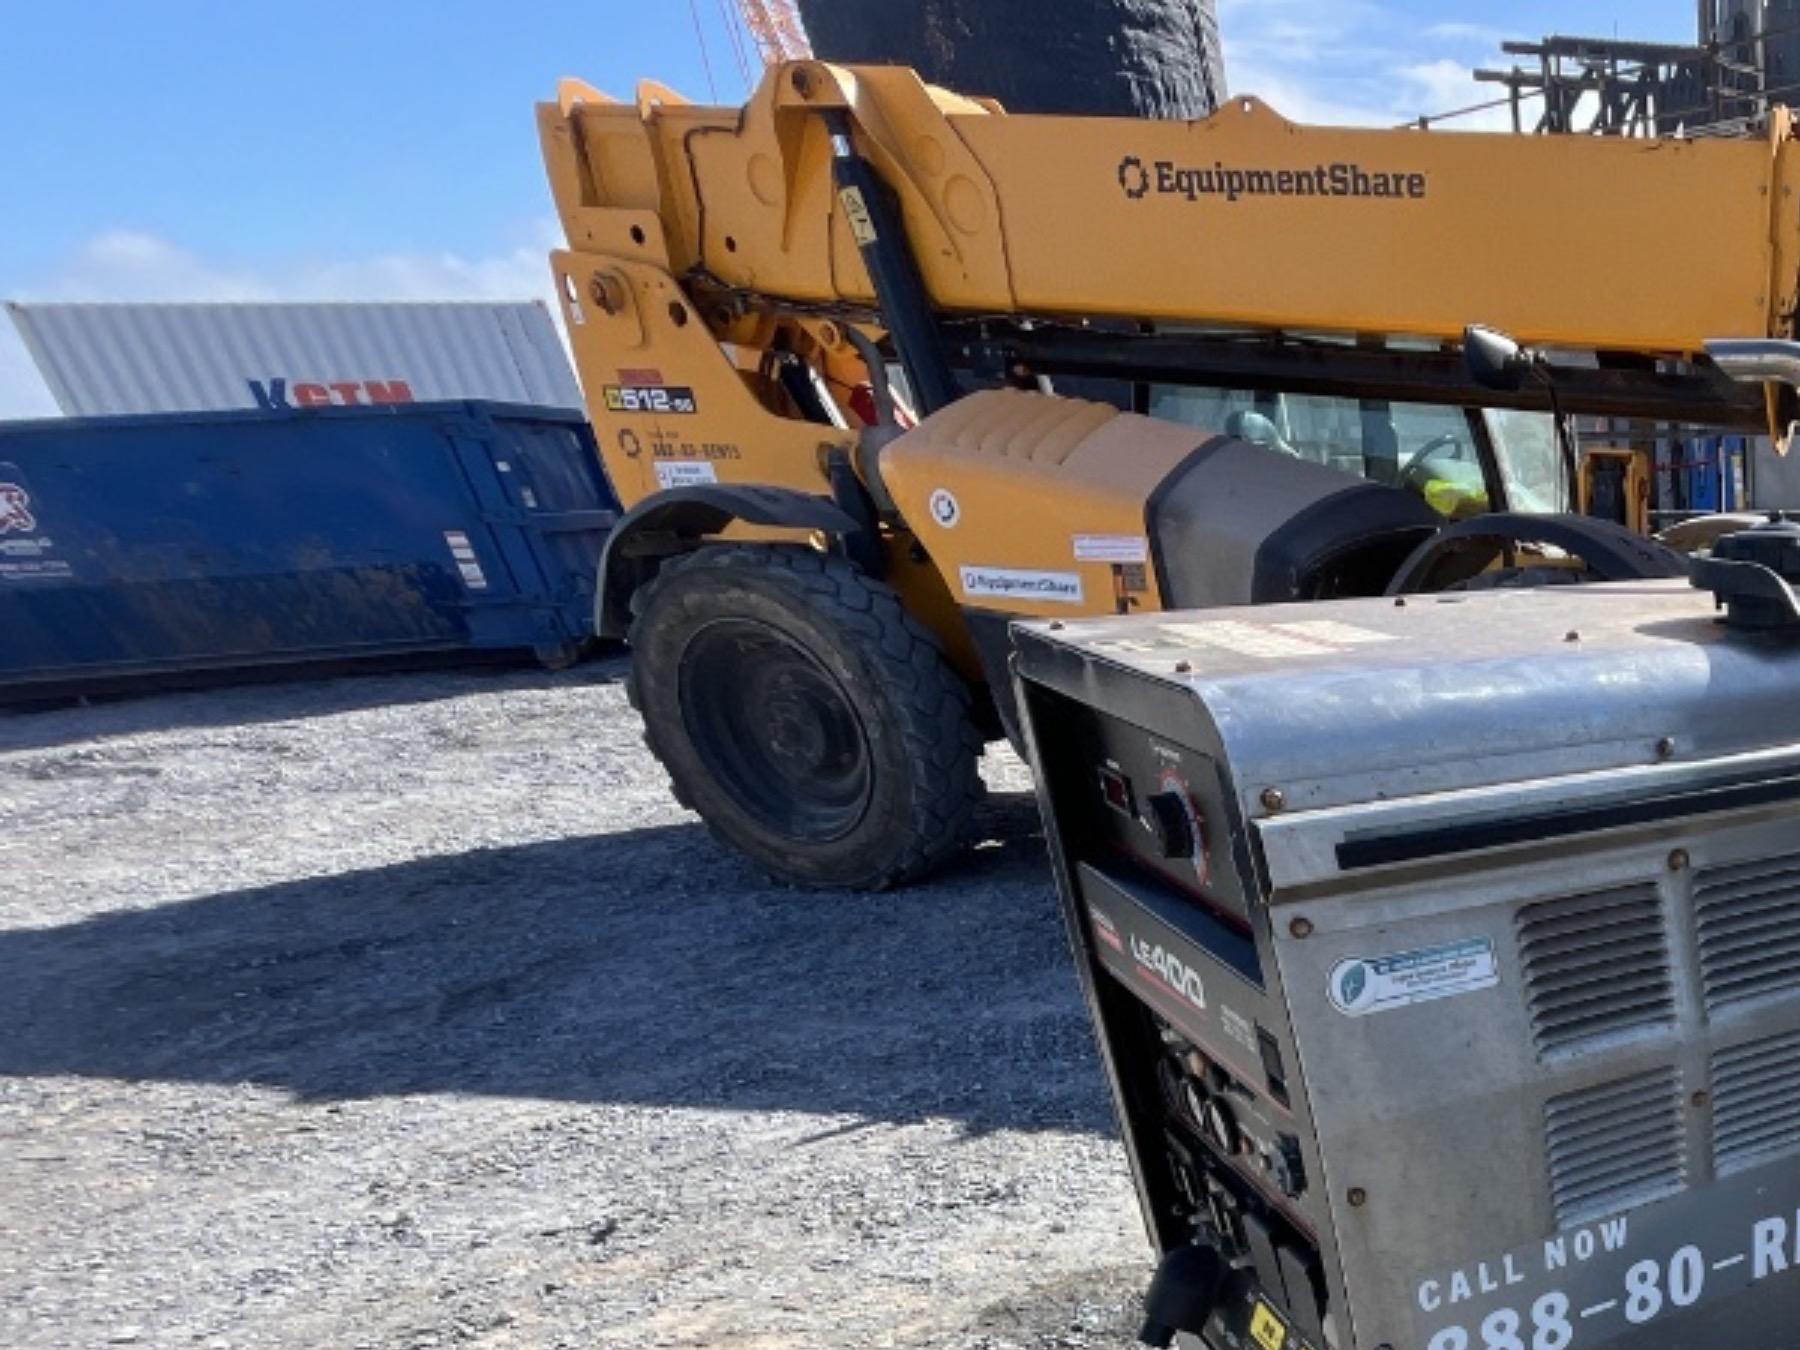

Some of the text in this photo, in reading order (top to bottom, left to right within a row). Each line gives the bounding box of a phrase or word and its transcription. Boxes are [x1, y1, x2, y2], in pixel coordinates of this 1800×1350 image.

[1154, 161, 1426, 201] EquipmentShare
[1418, 1217, 1629, 1312] CALL NOW
